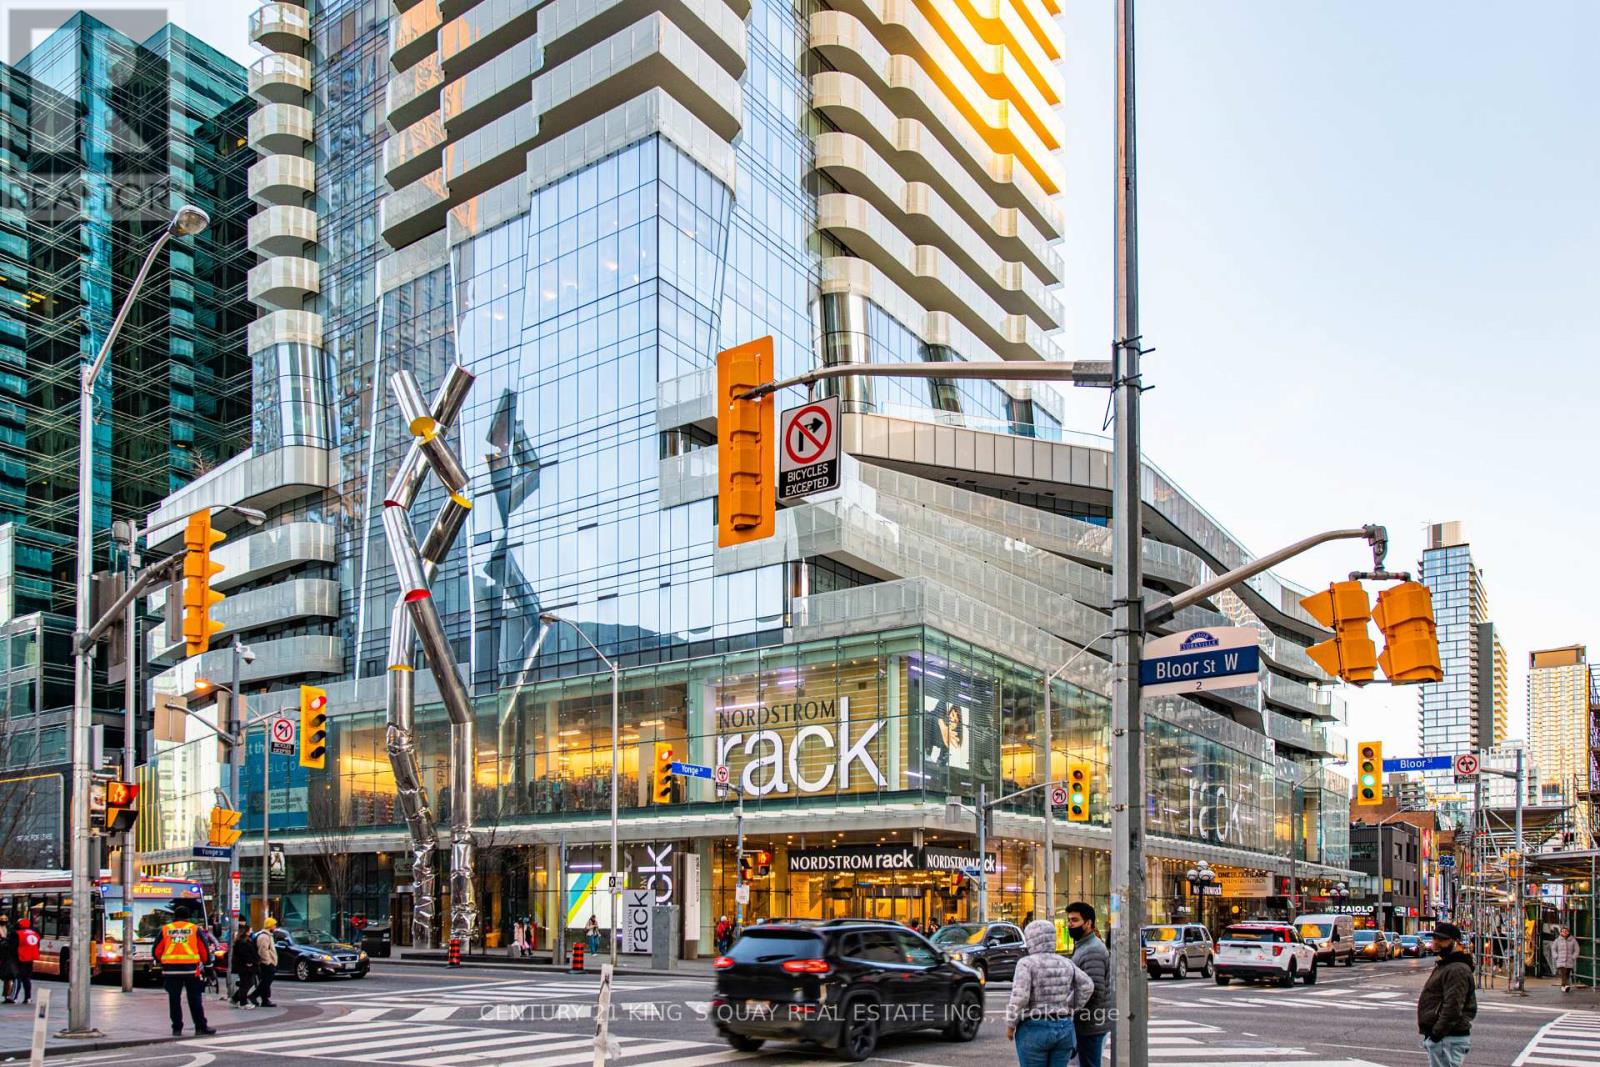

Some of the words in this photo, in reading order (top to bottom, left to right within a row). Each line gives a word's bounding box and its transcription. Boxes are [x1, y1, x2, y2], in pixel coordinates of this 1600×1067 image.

[787, 463, 829, 482] BICYCLES
[785, 476, 829, 496] EXCEPTED
[1156, 661, 1199, 679] Bloor
[1203, 659, 1216, 674] St
[1224, 652, 1239, 671] W
[1196, 681, 1202, 690] 2
[719, 699, 836, 729] NORDSTROM
[716, 696, 888, 796] rack
[681, 765, 699, 776] Yonge
[1400, 759, 1426, 769] Bloor
[201, 848, 219, 856] Yonge
[790, 854, 873, 870] NORDSTROM
[876, 849, 914, 868] rack
[927, 854, 975, 869] NORDSTROM
[975, 855, 995, 872] rck
[628, 891, 649, 953] rack
